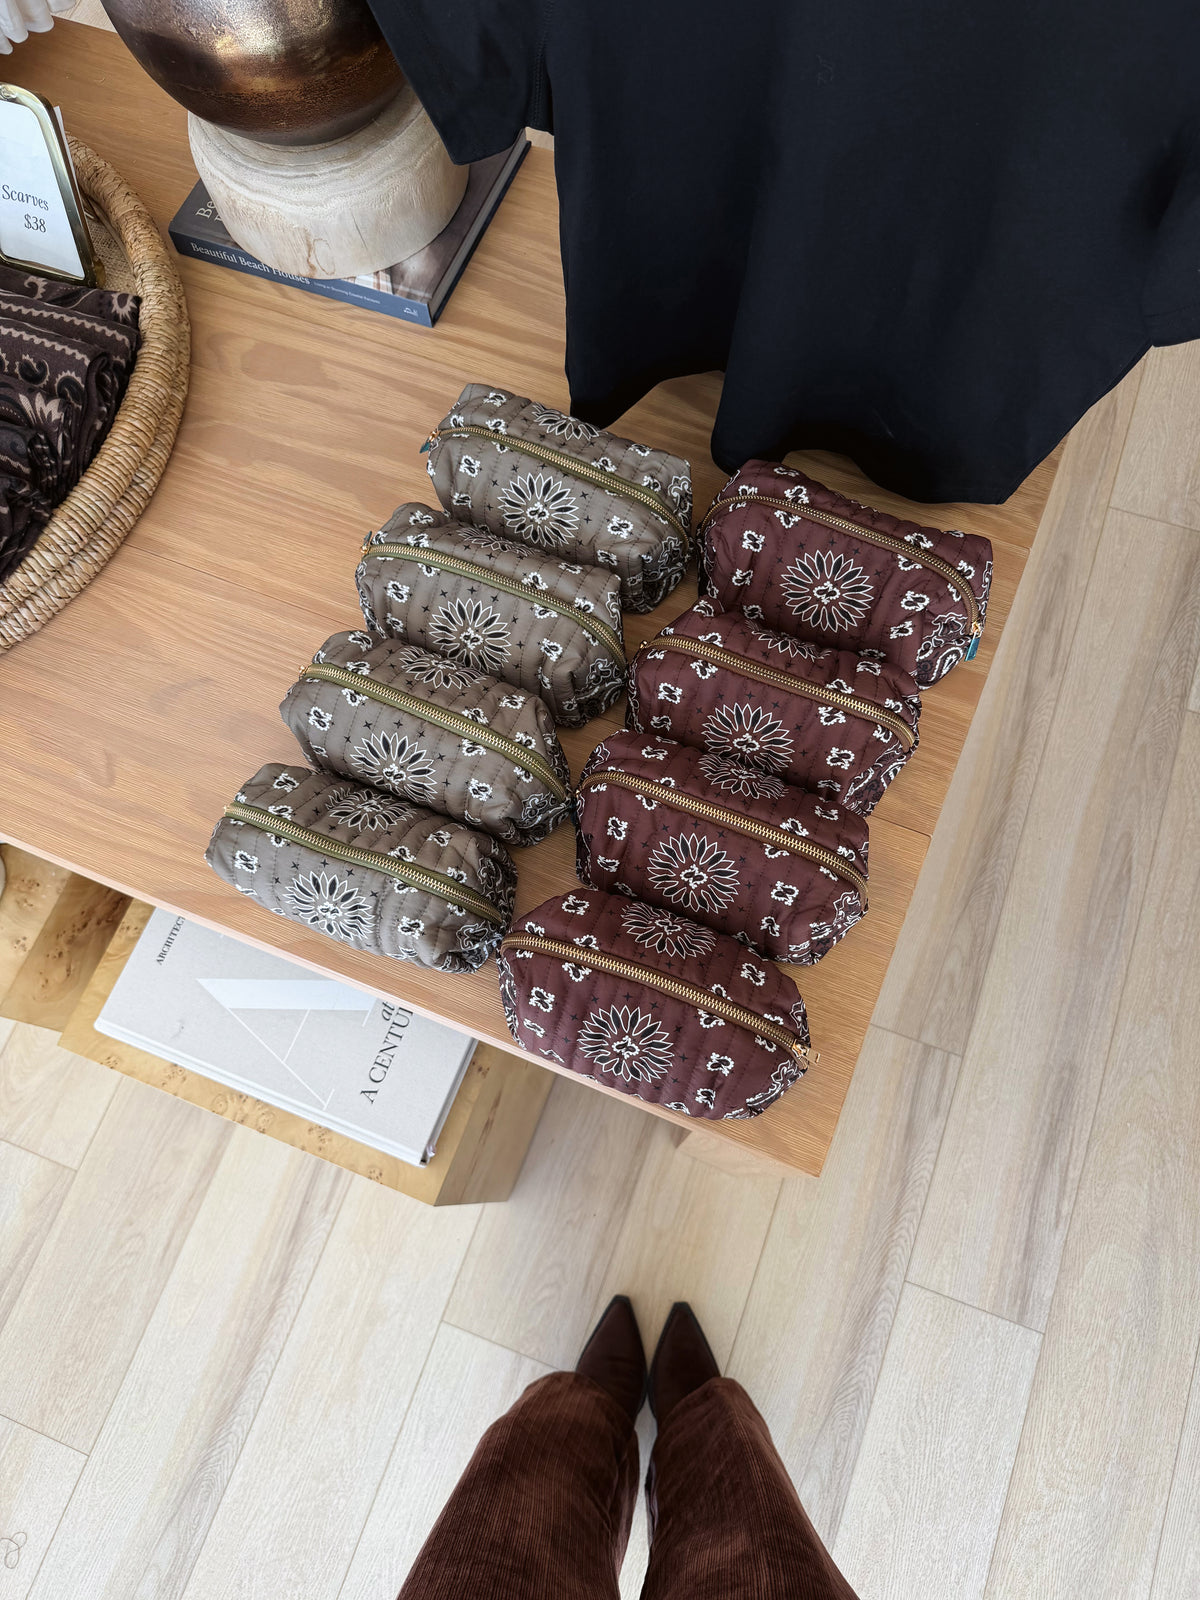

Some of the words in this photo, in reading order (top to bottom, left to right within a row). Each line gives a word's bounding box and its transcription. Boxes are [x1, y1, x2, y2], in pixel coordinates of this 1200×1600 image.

[2, 184, 49, 211] Scarves
[24, 213, 47, 233] $38
[190, 242, 238, 263] Beautiful
[238, 256, 270, 273] Beach
[360, 1088, 379, 1104] A
